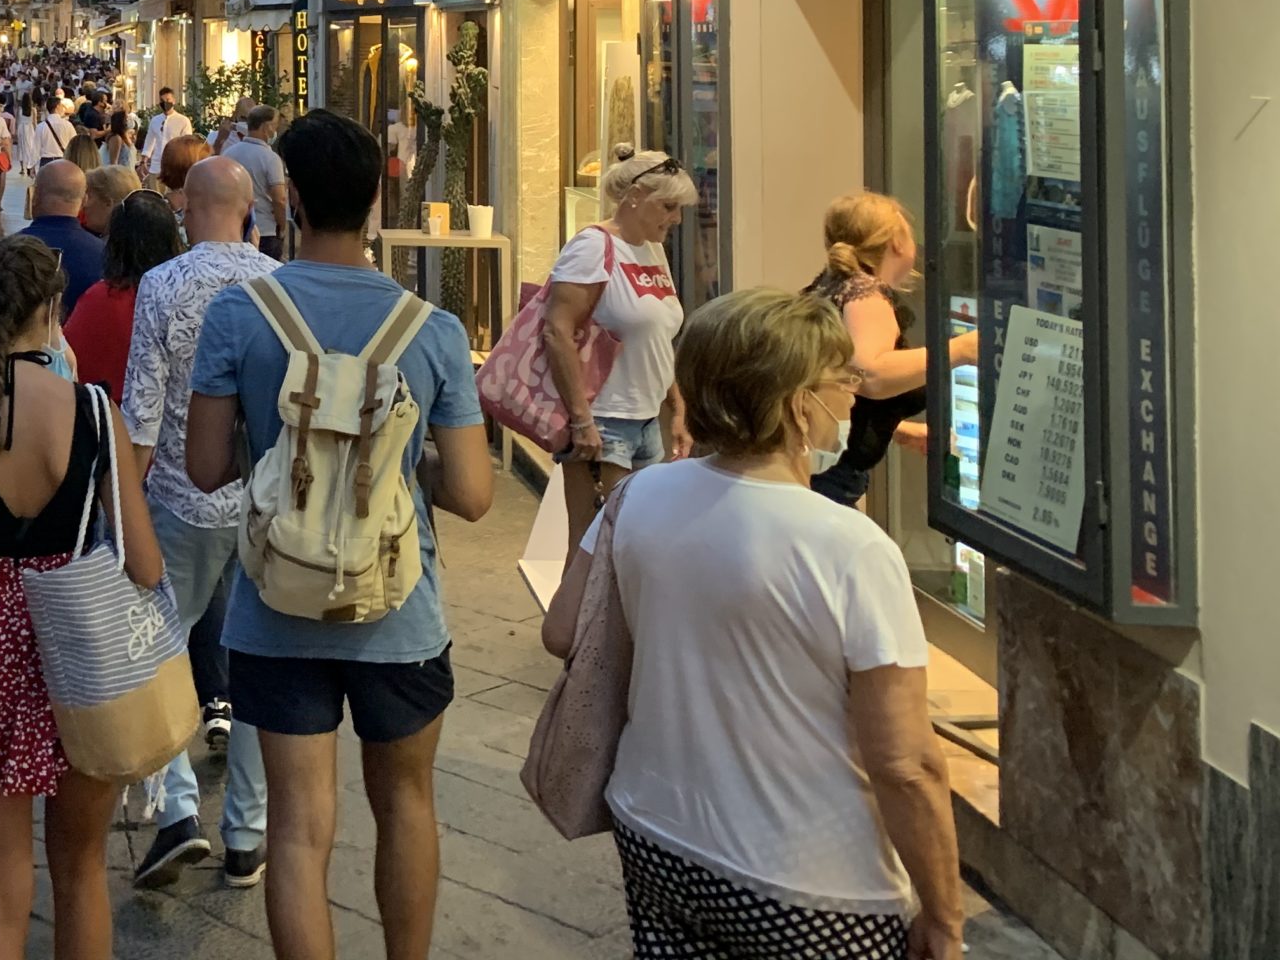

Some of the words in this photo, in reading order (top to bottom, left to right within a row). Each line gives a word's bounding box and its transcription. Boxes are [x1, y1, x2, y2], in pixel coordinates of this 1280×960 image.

[296, 11, 308, 117] HOTEL
[1135, 67, 1152, 314] AUSFLÜGE
[1024, 336, 1039, 348] USD
[1018, 370, 1033, 381] JPY
[1015, 386, 1031, 398] CHF
[1010, 419, 1025, 432] SEK
[1140, 338, 1158, 577] EXCHANGE
